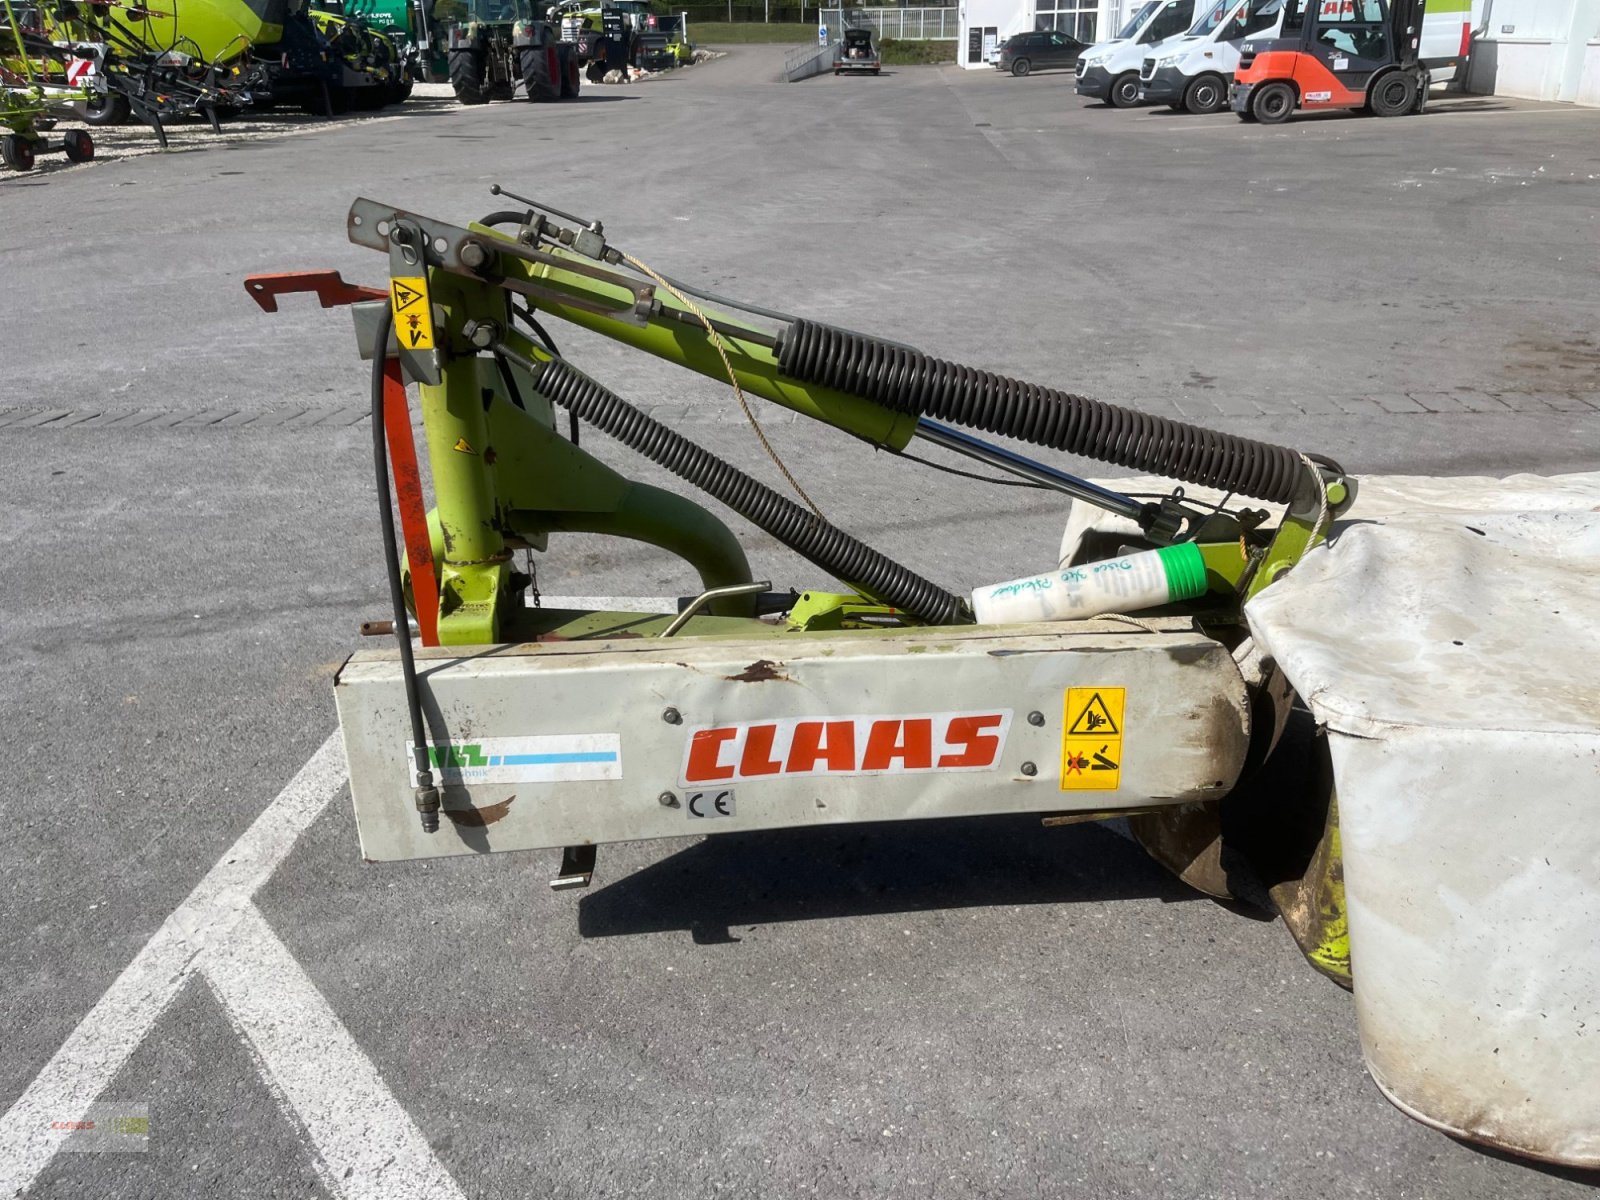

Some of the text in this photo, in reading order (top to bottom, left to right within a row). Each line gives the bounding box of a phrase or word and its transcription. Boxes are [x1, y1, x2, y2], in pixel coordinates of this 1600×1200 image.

[1093, 559, 1132, 573] Disco
[685, 715, 1003, 782] CLAAS
[689, 791, 730, 817] CE
